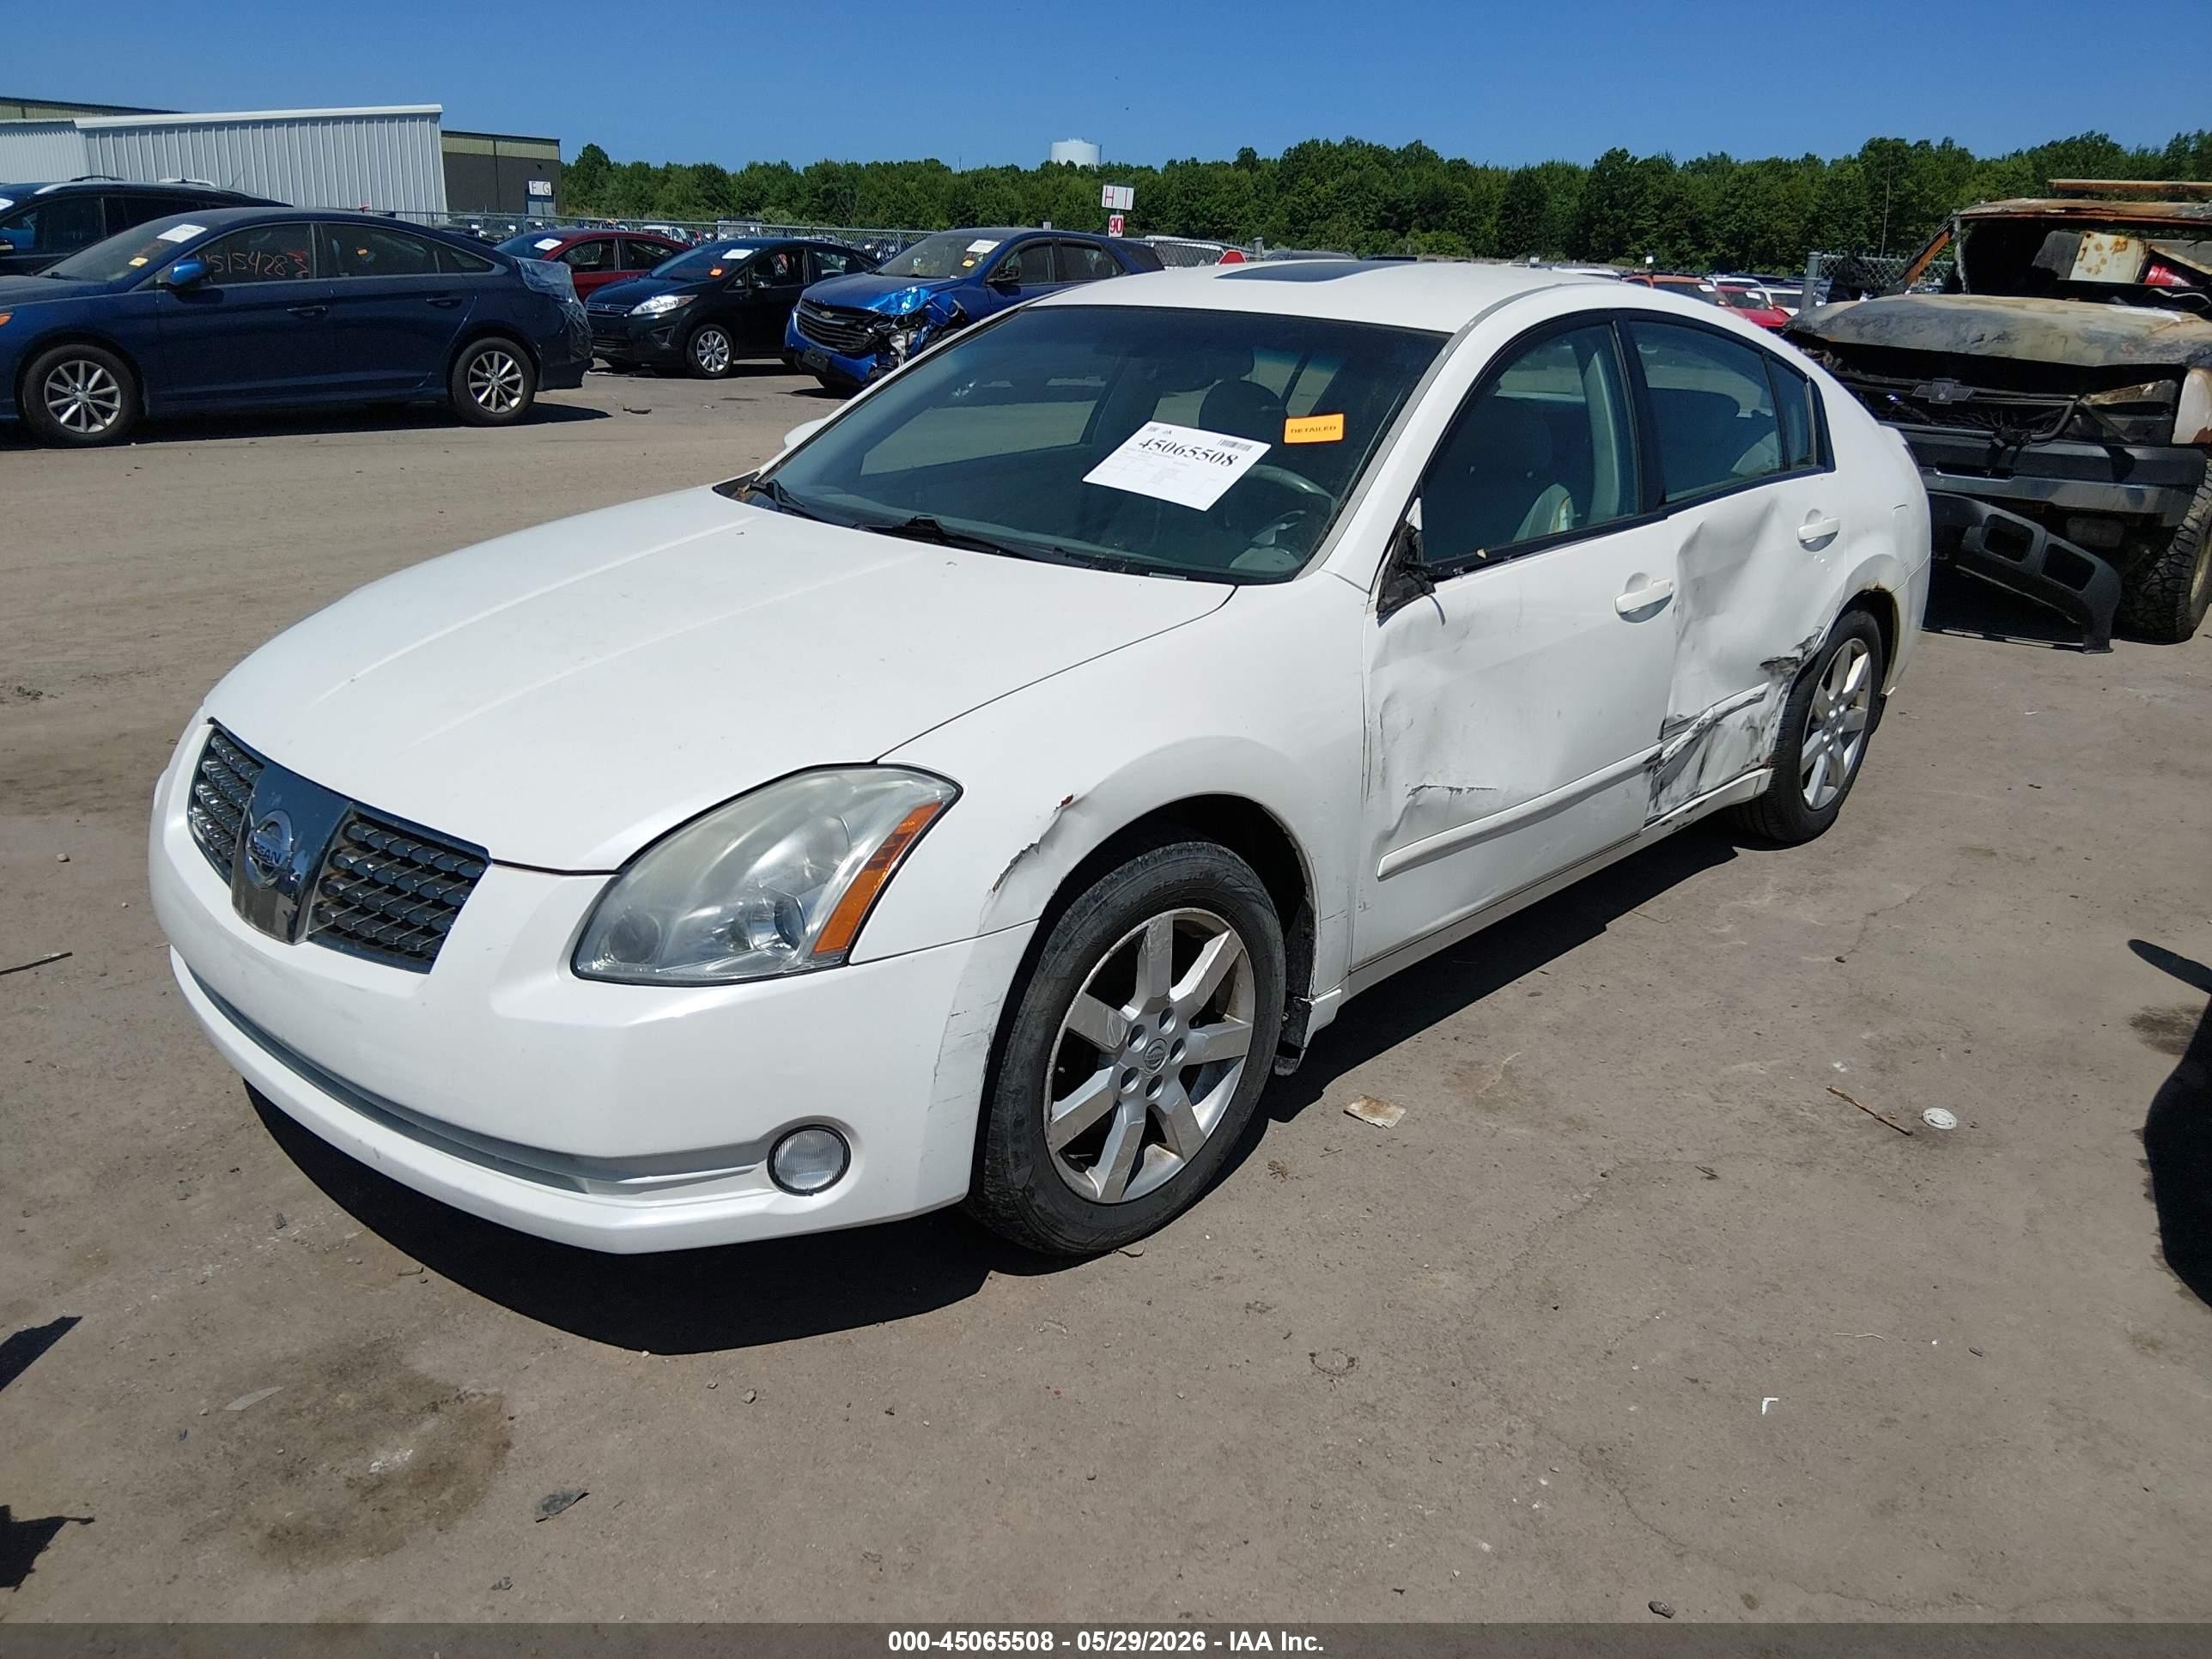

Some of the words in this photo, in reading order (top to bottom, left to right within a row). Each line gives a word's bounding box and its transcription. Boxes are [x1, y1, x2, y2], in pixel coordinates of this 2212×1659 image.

[532, 181, 537, 194] F
[542, 182, 550, 195] G
[1104, 186, 1115, 207] H
[1109, 217, 1124, 234] 90
[1291, 425, 1337, 434] DETAILED
[1138, 437, 1239, 468] 45065508
